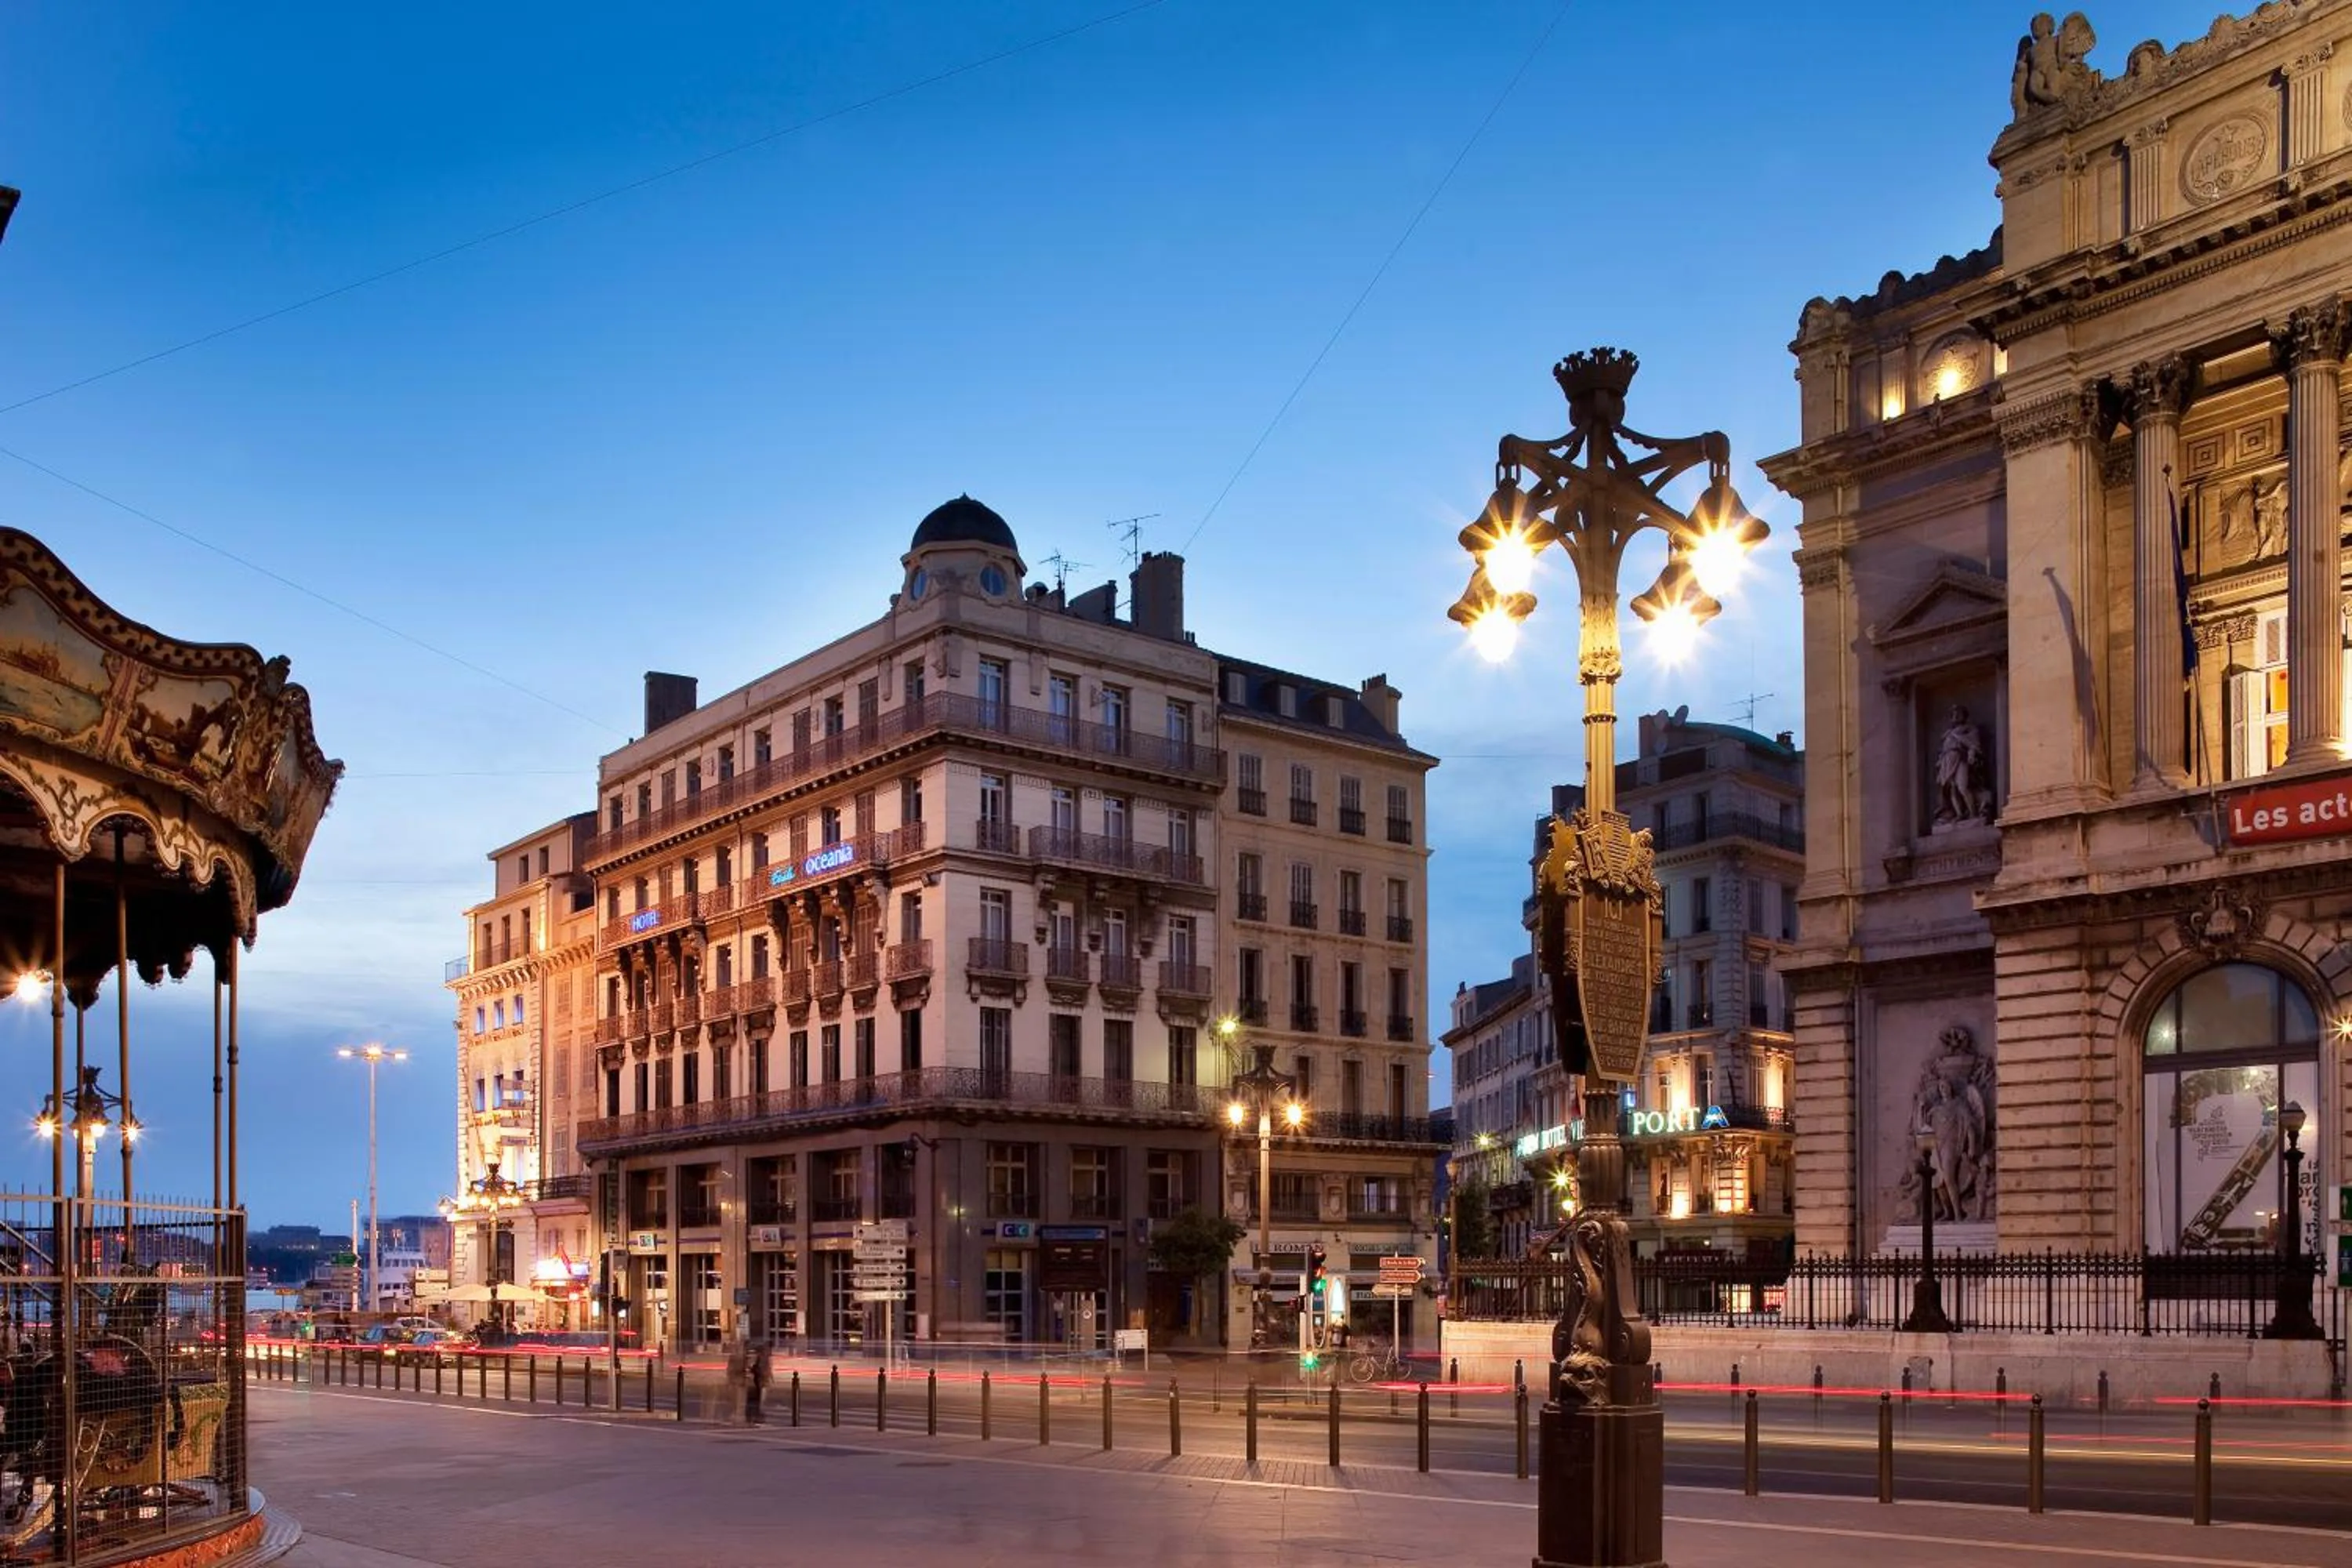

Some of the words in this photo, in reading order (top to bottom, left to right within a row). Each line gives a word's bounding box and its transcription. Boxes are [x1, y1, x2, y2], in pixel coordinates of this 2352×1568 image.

[2234, 806, 2288, 833] Les
[2299, 792, 2352, 824] act
[1632, 1106, 1700, 1135] PORT
